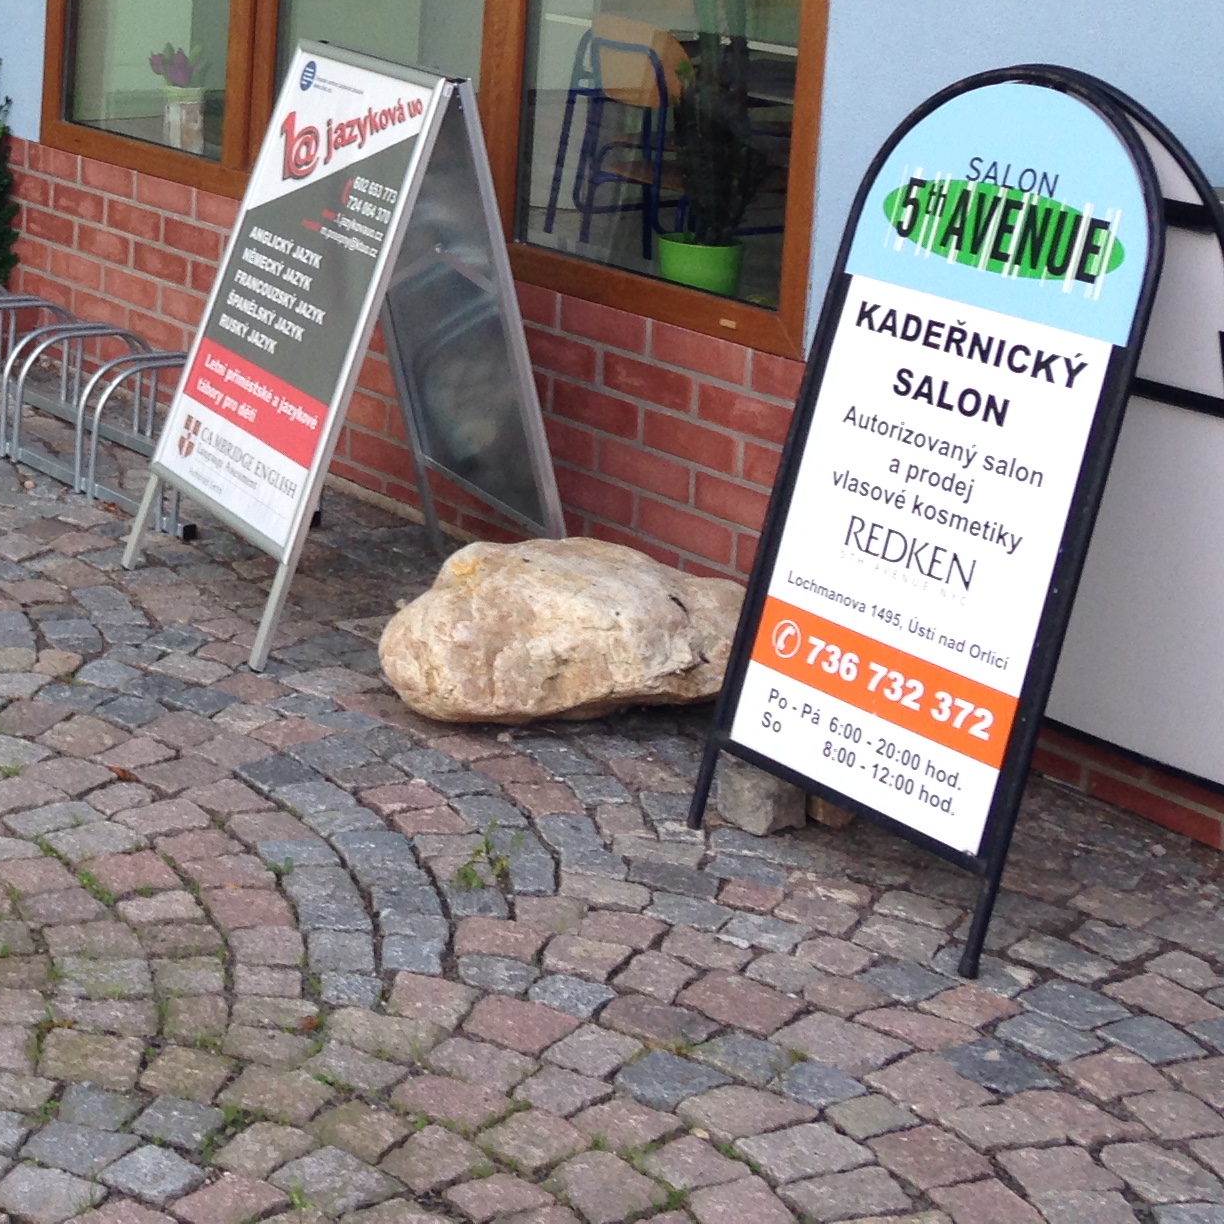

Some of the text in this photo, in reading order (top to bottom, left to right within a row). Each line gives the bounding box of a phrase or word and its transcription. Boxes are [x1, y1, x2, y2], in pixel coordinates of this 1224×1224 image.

[323, 98, 406, 165] jazyková
[407, 98, 423, 118] uo
[346, 195, 363, 213] 724
[382, 187, 398, 204] 773
[965, 156, 1060, 198] SALON
[249, 226, 294, 255] ANGLICKÝ
[292, 246, 322, 269] JAZYK
[940, 189, 1111, 284] AVENUE
[234, 269, 326, 325] FRANCOUZSKÝ JAZYK
[242, 247, 313, 291] NĚMECKÝ JAZYK
[218, 313, 277, 354] RUSKÝ JAZYK
[227, 289, 305, 342] ŠPANĚLSKÝ JAZYK
[855, 301, 1089, 389] KADEŘNICKÝ
[272, 396, 279, 407] a
[278, 396, 319, 430] jazykové
[893, 368, 1010, 427] SALON
[200, 427, 255, 472] CAMBRIDGE
[254, 461, 298, 499] ENGLISH
[842, 405, 1044, 487] Autorizovaný salon
[833, 470, 1023, 555] vlasové kosmetiky
[889, 458, 975, 504] a prodej
[844, 515, 977, 592] REDKEN
[787, 570, 866, 614] Lochmanova
[870, 604, 902, 630] 1495,
[907, 616, 936, 642] Ústí
[938, 634, 966, 654] nad
[805, 635, 995, 742] 736 732 372
[761, 711, 782, 733] So
[822, 740, 856, 767] 8:00
[871, 763, 914, 795] 12:00
[918, 784, 956, 816] hod.
[767, 688, 788, 709] Po
[800, 702, 821, 725] Pá
[828, 716, 862, 743] 6:00
[875, 738, 921, 771] 20:00
[925, 759, 962, 791] hod.
